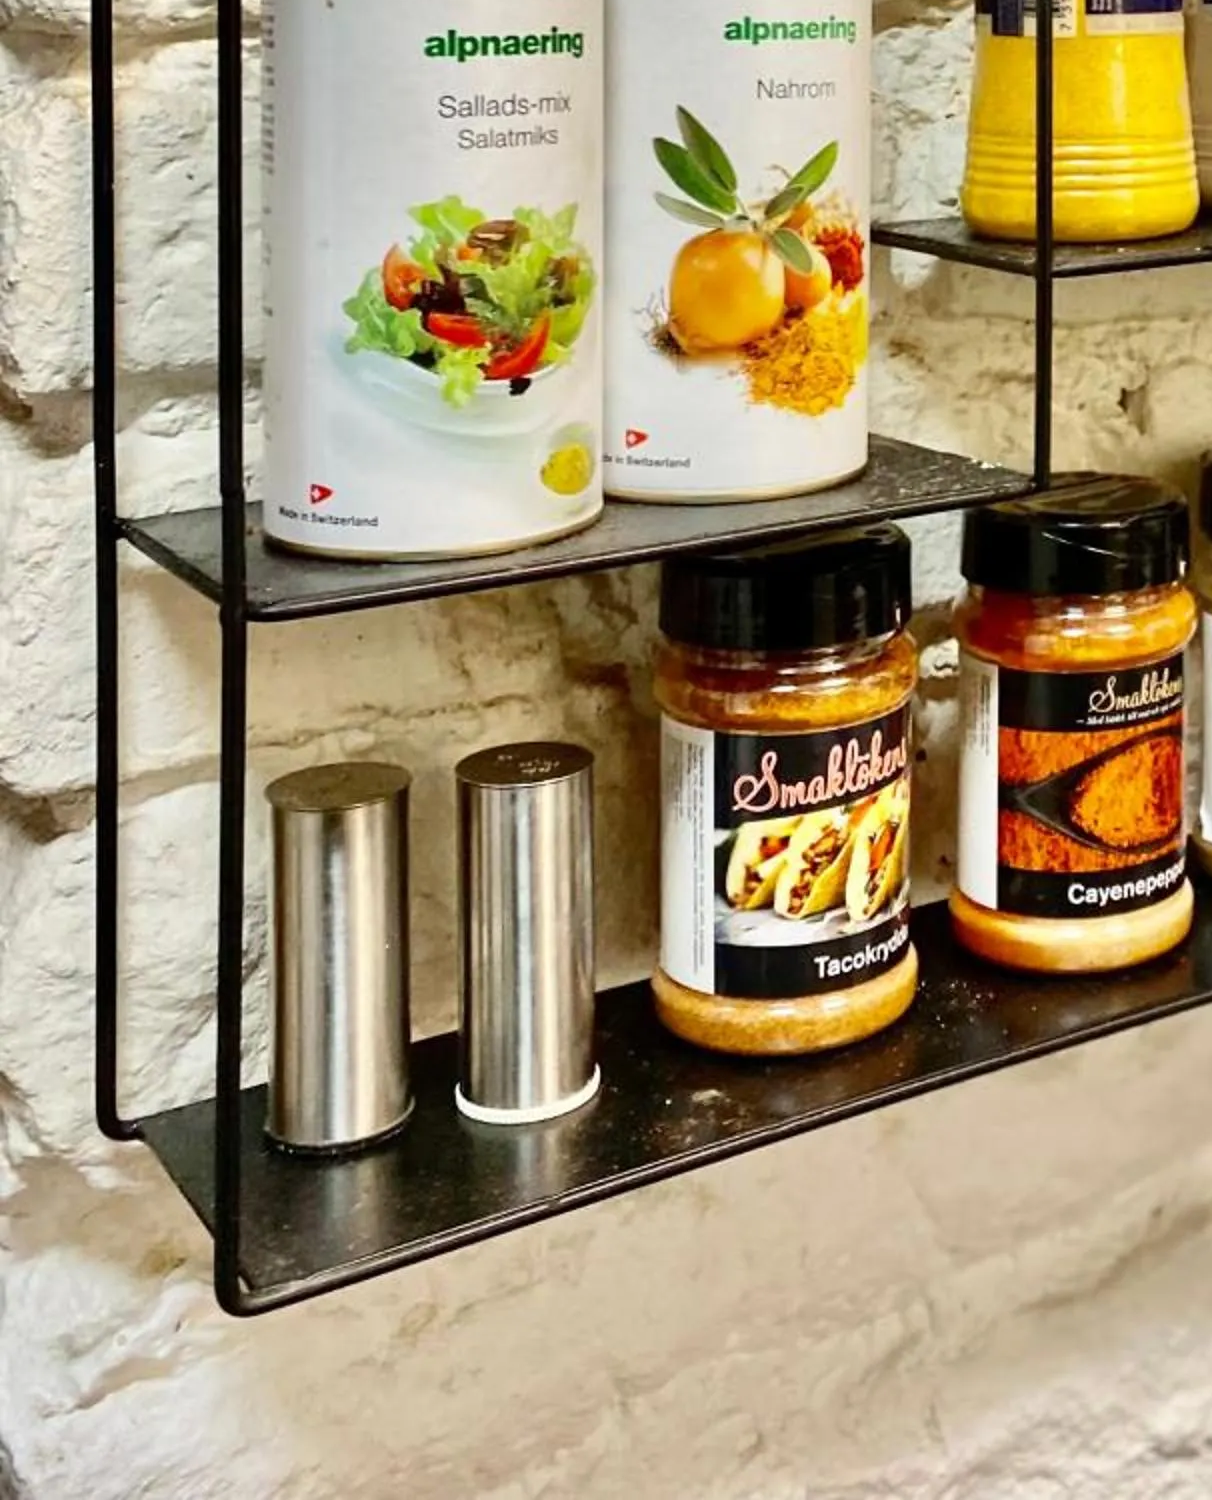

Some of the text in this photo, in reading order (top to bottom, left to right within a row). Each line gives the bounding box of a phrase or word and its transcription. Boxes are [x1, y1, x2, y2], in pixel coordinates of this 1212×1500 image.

[724, 14, 857, 45] alpnaering
[424, 25, 584, 63] alpnaering
[756, 78, 836, 99] Nahrom
[437, 91, 572, 119] Sallads-mix
[457, 125, 559, 150] Salatmiks
